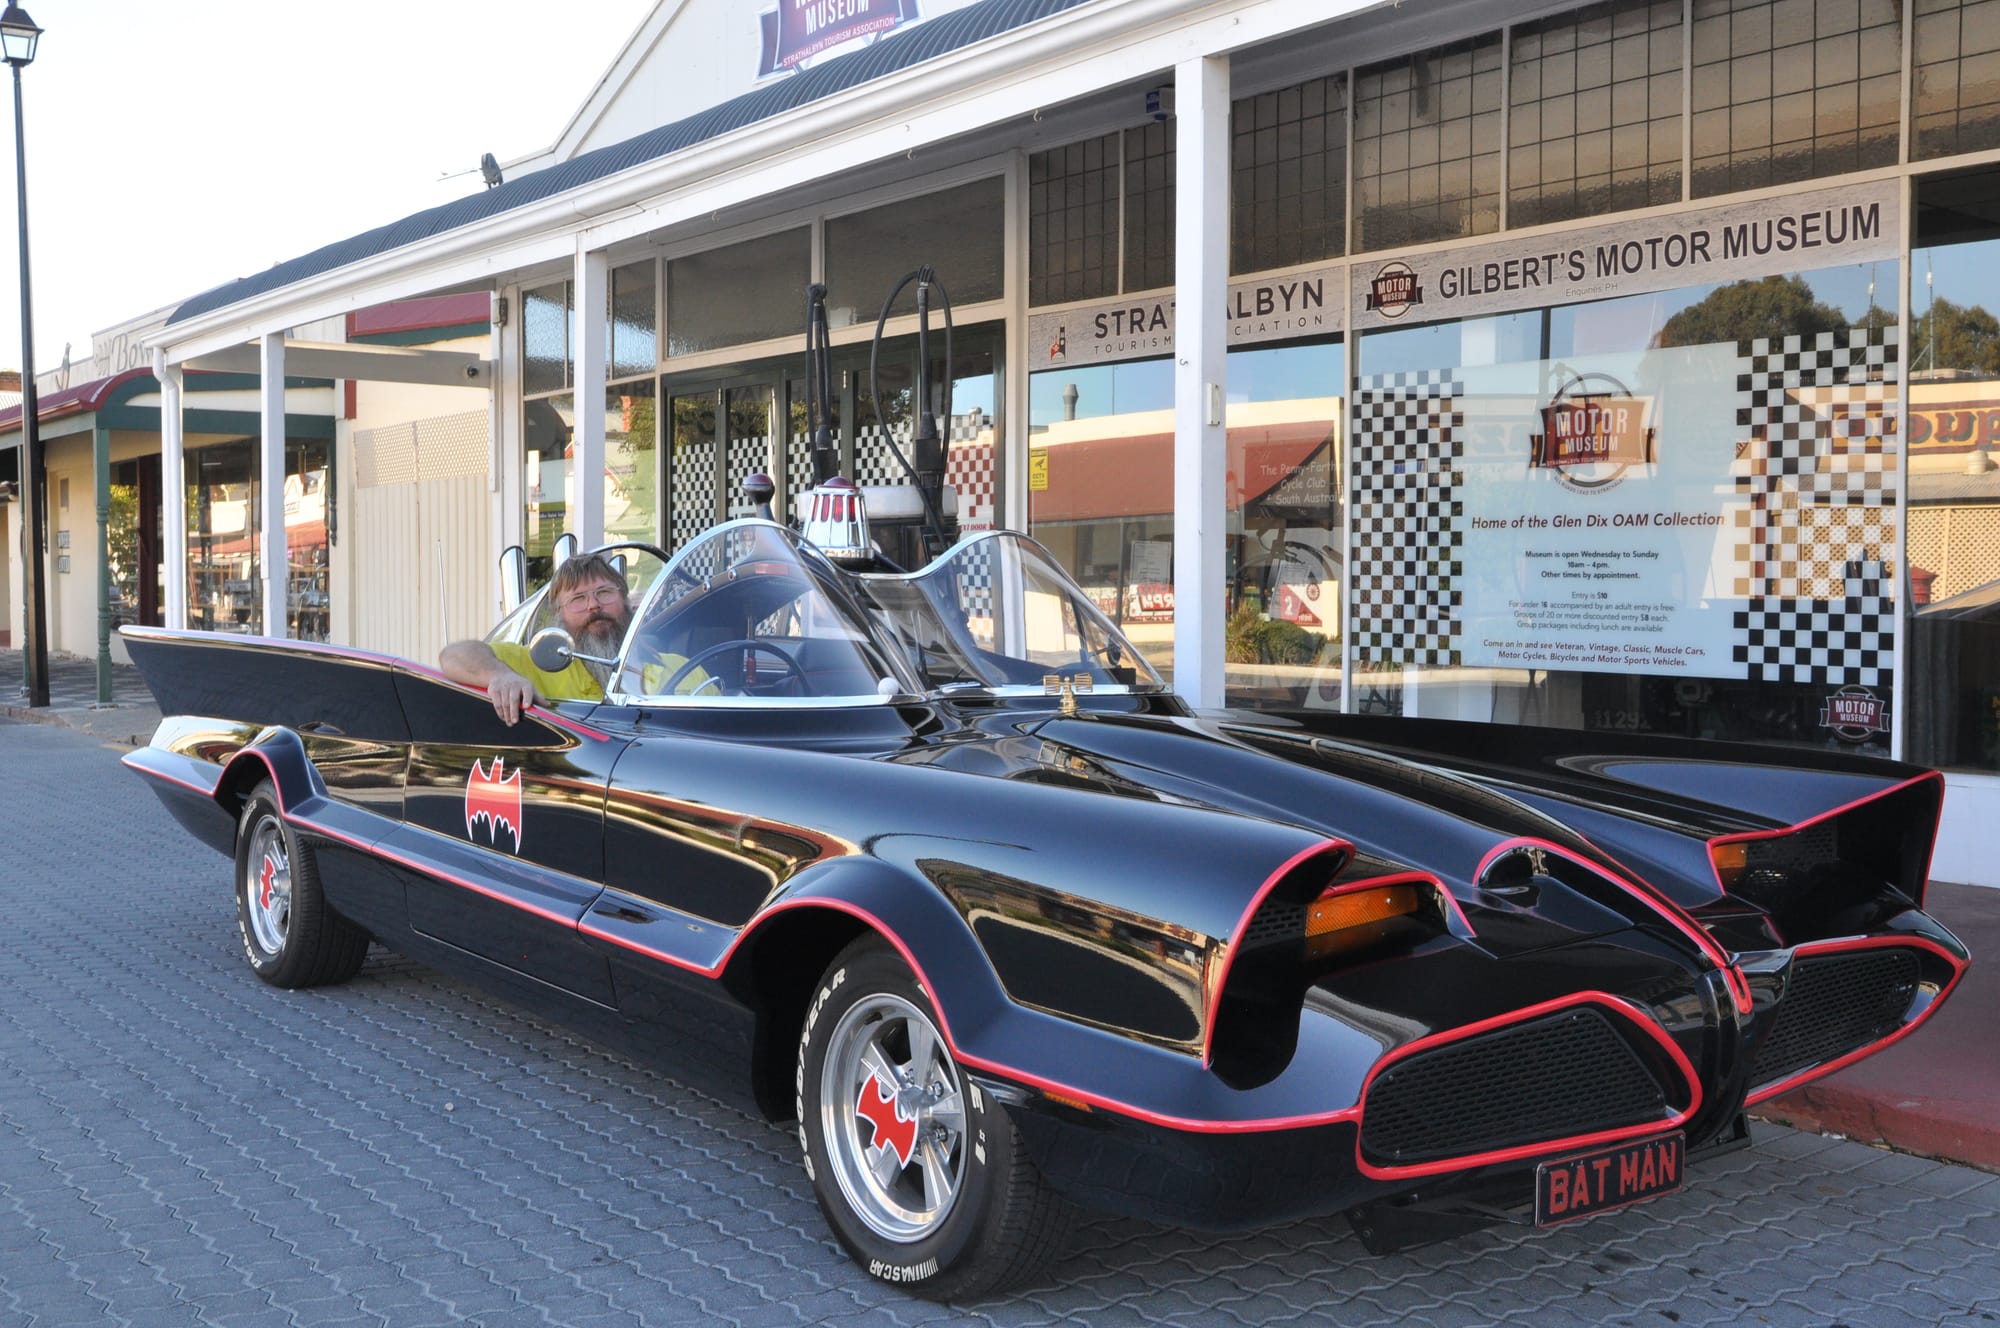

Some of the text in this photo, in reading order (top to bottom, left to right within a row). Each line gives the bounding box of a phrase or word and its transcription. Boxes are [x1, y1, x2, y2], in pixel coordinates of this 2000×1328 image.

[805, 0, 869, 35] MUSEUM
[824, 29, 852, 46] TOURISM
[852, 15, 896, 35] ASSOCIATION
[1439, 202, 1880, 299] GILBERT'S MOTOR MUSEUM
[1377, 277, 1411, 295] MOTOR
[1382, 291, 1408, 302] MUSEUM
[1094, 278, 1323, 339] STRALBYN
[1094, 335, 1172, 355] TOURISM
[1555, 408, 1628, 438] MOTOR
[1565, 436, 1619, 454] MUSEUM
[1260, 465, 1277, 476] The
[1281, 478, 1326, 492] Cycle Club
[1276, 494, 1302, 505] South
[1471, 512, 1725, 529] Home of the Glen Dix OAM Collection
[1525, 550, 1552, 558] Museum
[1554, 550, 1560, 558] is
[1562, 551, 1579, 559] open
[1581, 550, 1621, 560] Wednesday
[1632, 550, 1659, 560] Sunday
[1541, 570, 1640, 580] Other times by appointment.
[1571, 591, 1588, 600] Entry
[1550, 601, 1594, 610] accompanied
[1594, 601, 1603, 611] by
[1614, 603, 1632, 611] adult
[1633, 603, 1651, 612] entry
[1546, 611, 1554, 619] 20
[1583, 612, 1620, 620] discounted
[1621, 614, 1639, 623] entry
[1538, 621, 1568, 630] packages
[1570, 622, 1600, 632] including
[1601, 623, 1620, 631] lunch
[1483, 639, 1503, 648] Come
[1516, 640, 1523, 648] in
[1524, 640, 1539, 649] and
[1540, 642, 1553, 650] see
[1555, 641, 1586, 652] Veteran,
[1654, 645, 1683, 655] Muscle
[1685, 646, 1706, 657] Cars,
[1498, 650, 1521, 660] Motor
[1550, 652, 1579, 663] Bicycles
[1581, 653, 1596, 662] and
[1597, 654, 1621, 664] Motor
[1623, 655, 1650, 665] Sports
[1652, 656, 1688, 667] Vehicles.
[1835, 700, 1875, 716] MOTOR
[1840, 713, 1869, 723] MUSEUM
[1549, 1141, 1677, 1215] BAT MAN
